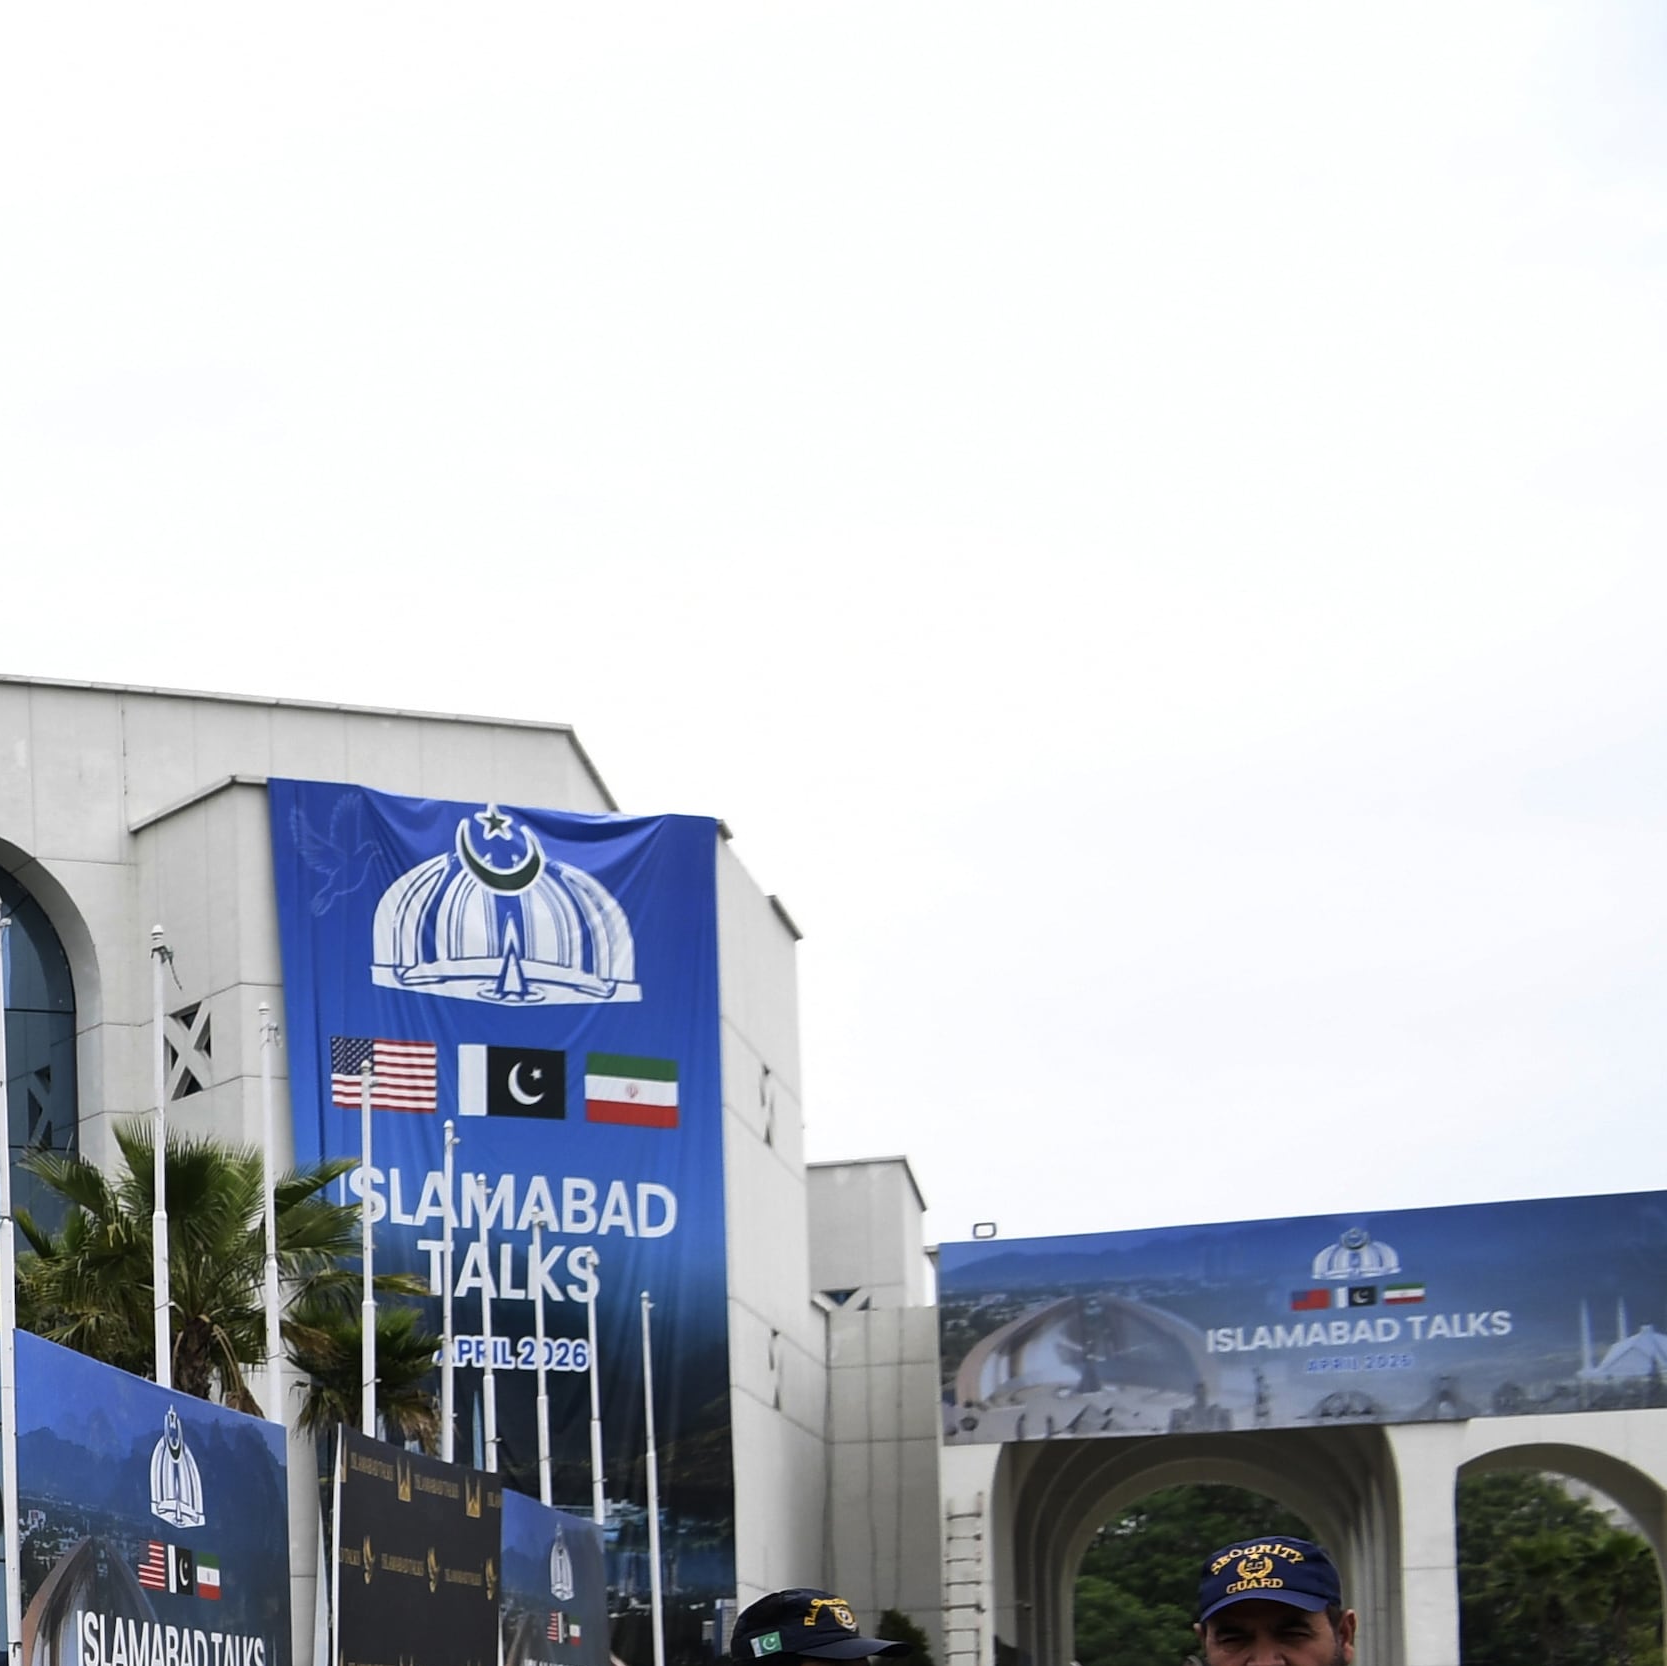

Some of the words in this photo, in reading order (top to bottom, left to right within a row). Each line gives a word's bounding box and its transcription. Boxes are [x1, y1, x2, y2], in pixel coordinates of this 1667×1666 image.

[417, 1239, 600, 1303] TALKS
[1206, 1318, 1400, 1353] ISLAMABAD
[1407, 1310, 1512, 1341] TALKS
[1226, 1578, 1283, 1594] GUARD
